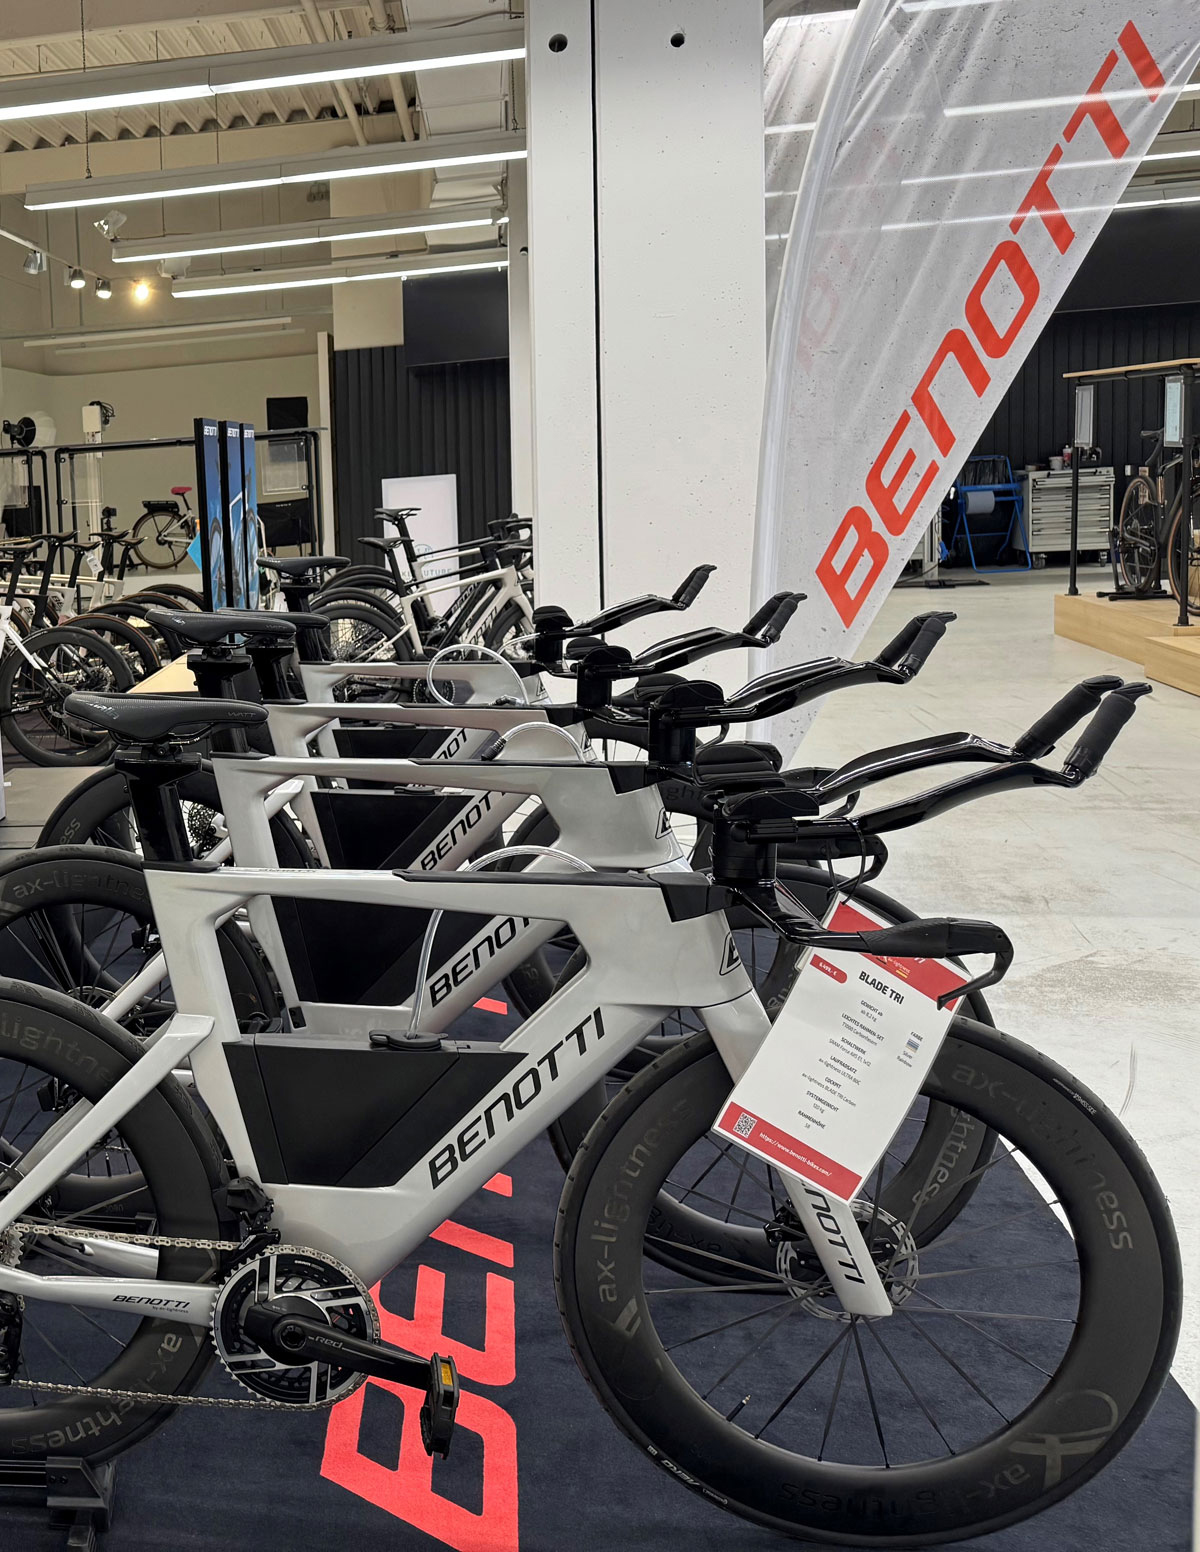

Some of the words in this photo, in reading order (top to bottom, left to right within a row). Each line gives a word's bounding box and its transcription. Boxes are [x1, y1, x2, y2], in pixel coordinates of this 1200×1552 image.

[815, 20, 1165, 628] BENOTTI
[858, 970, 889, 995] BLADE
[888, 988, 905, 1005] TRI
[910, 1031, 923, 1042] FARBE
[903, 1050, 913, 1060] Silver
[824, 1076, 842, 1089] COCKPIT
[428, 1006, 605, 1190] BENOTTI
[112, 1295, 190, 1309] BENOTTI
